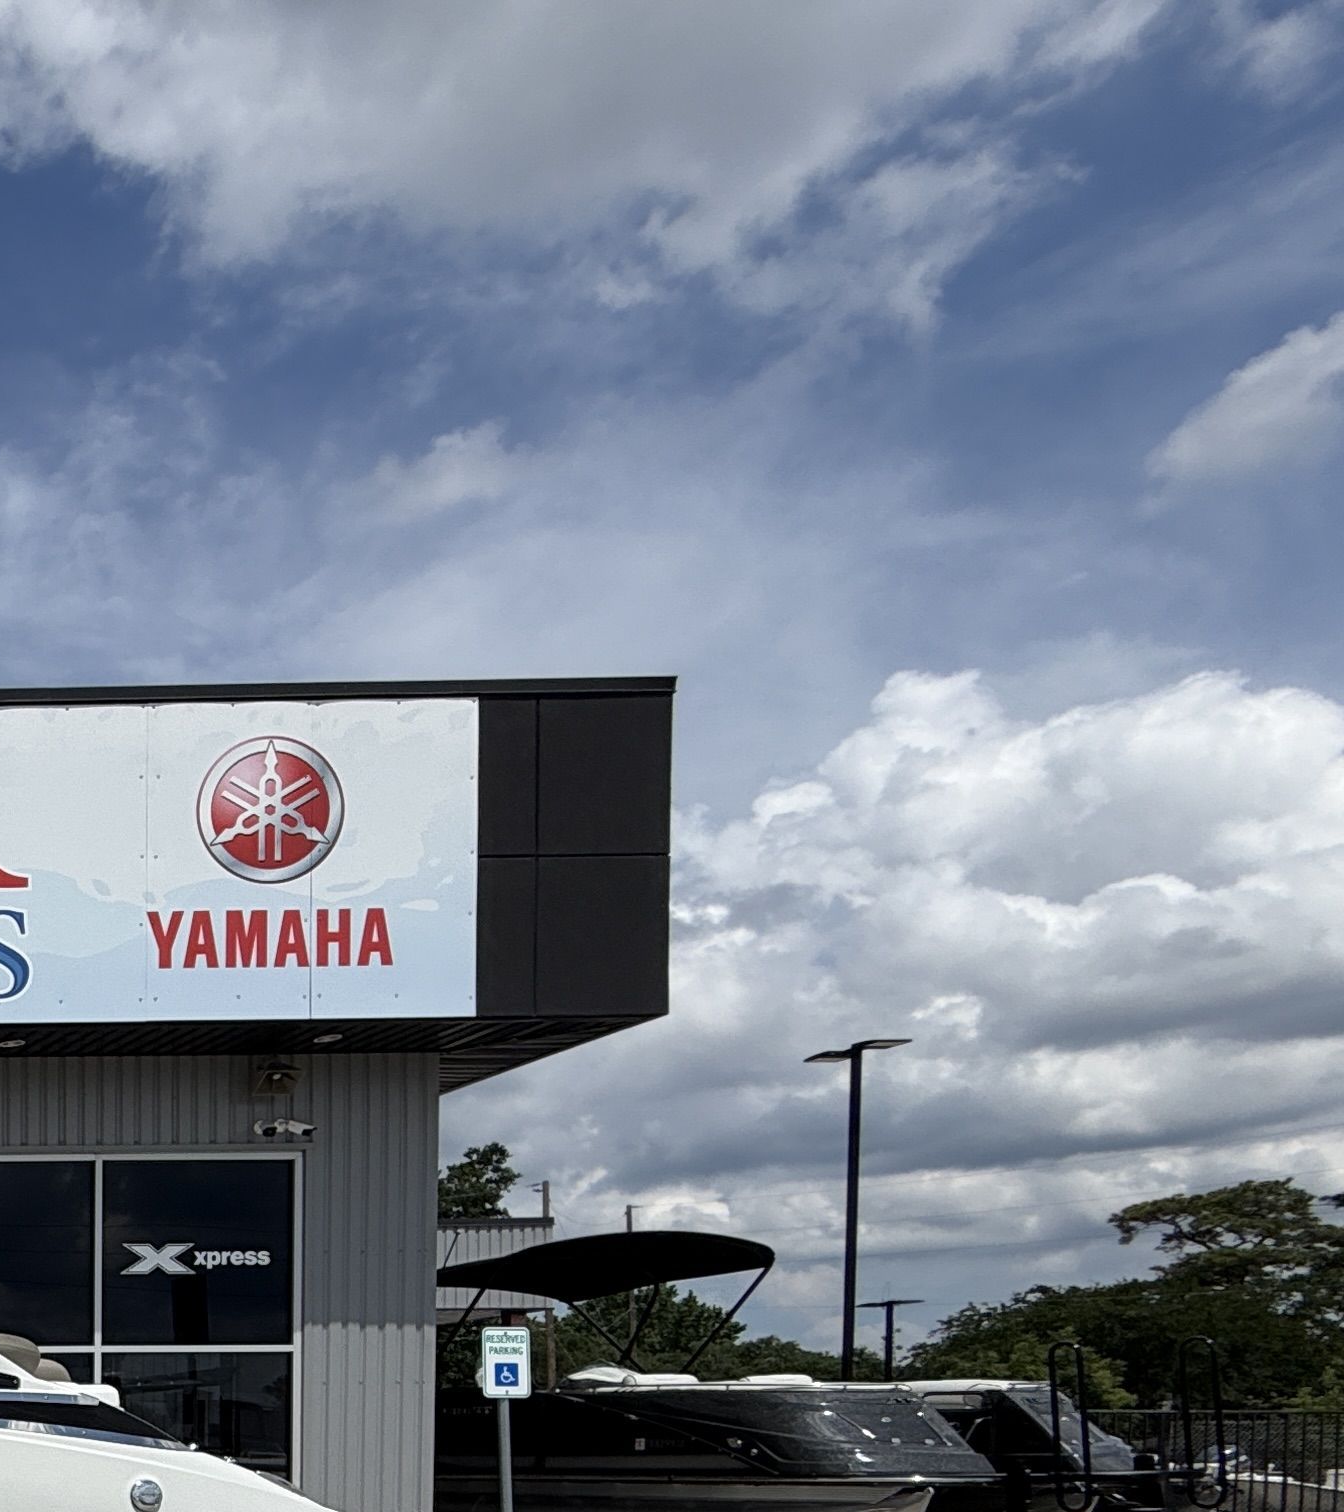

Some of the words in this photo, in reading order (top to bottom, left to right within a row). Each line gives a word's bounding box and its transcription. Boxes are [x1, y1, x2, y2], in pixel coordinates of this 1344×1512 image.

[147, 907, 393, 969] YAMAHA
[193, 1250, 272, 1270] xpress
[485, 1334, 526, 1344] RESERVED
[488, 1346, 524, 1356] PARKING
